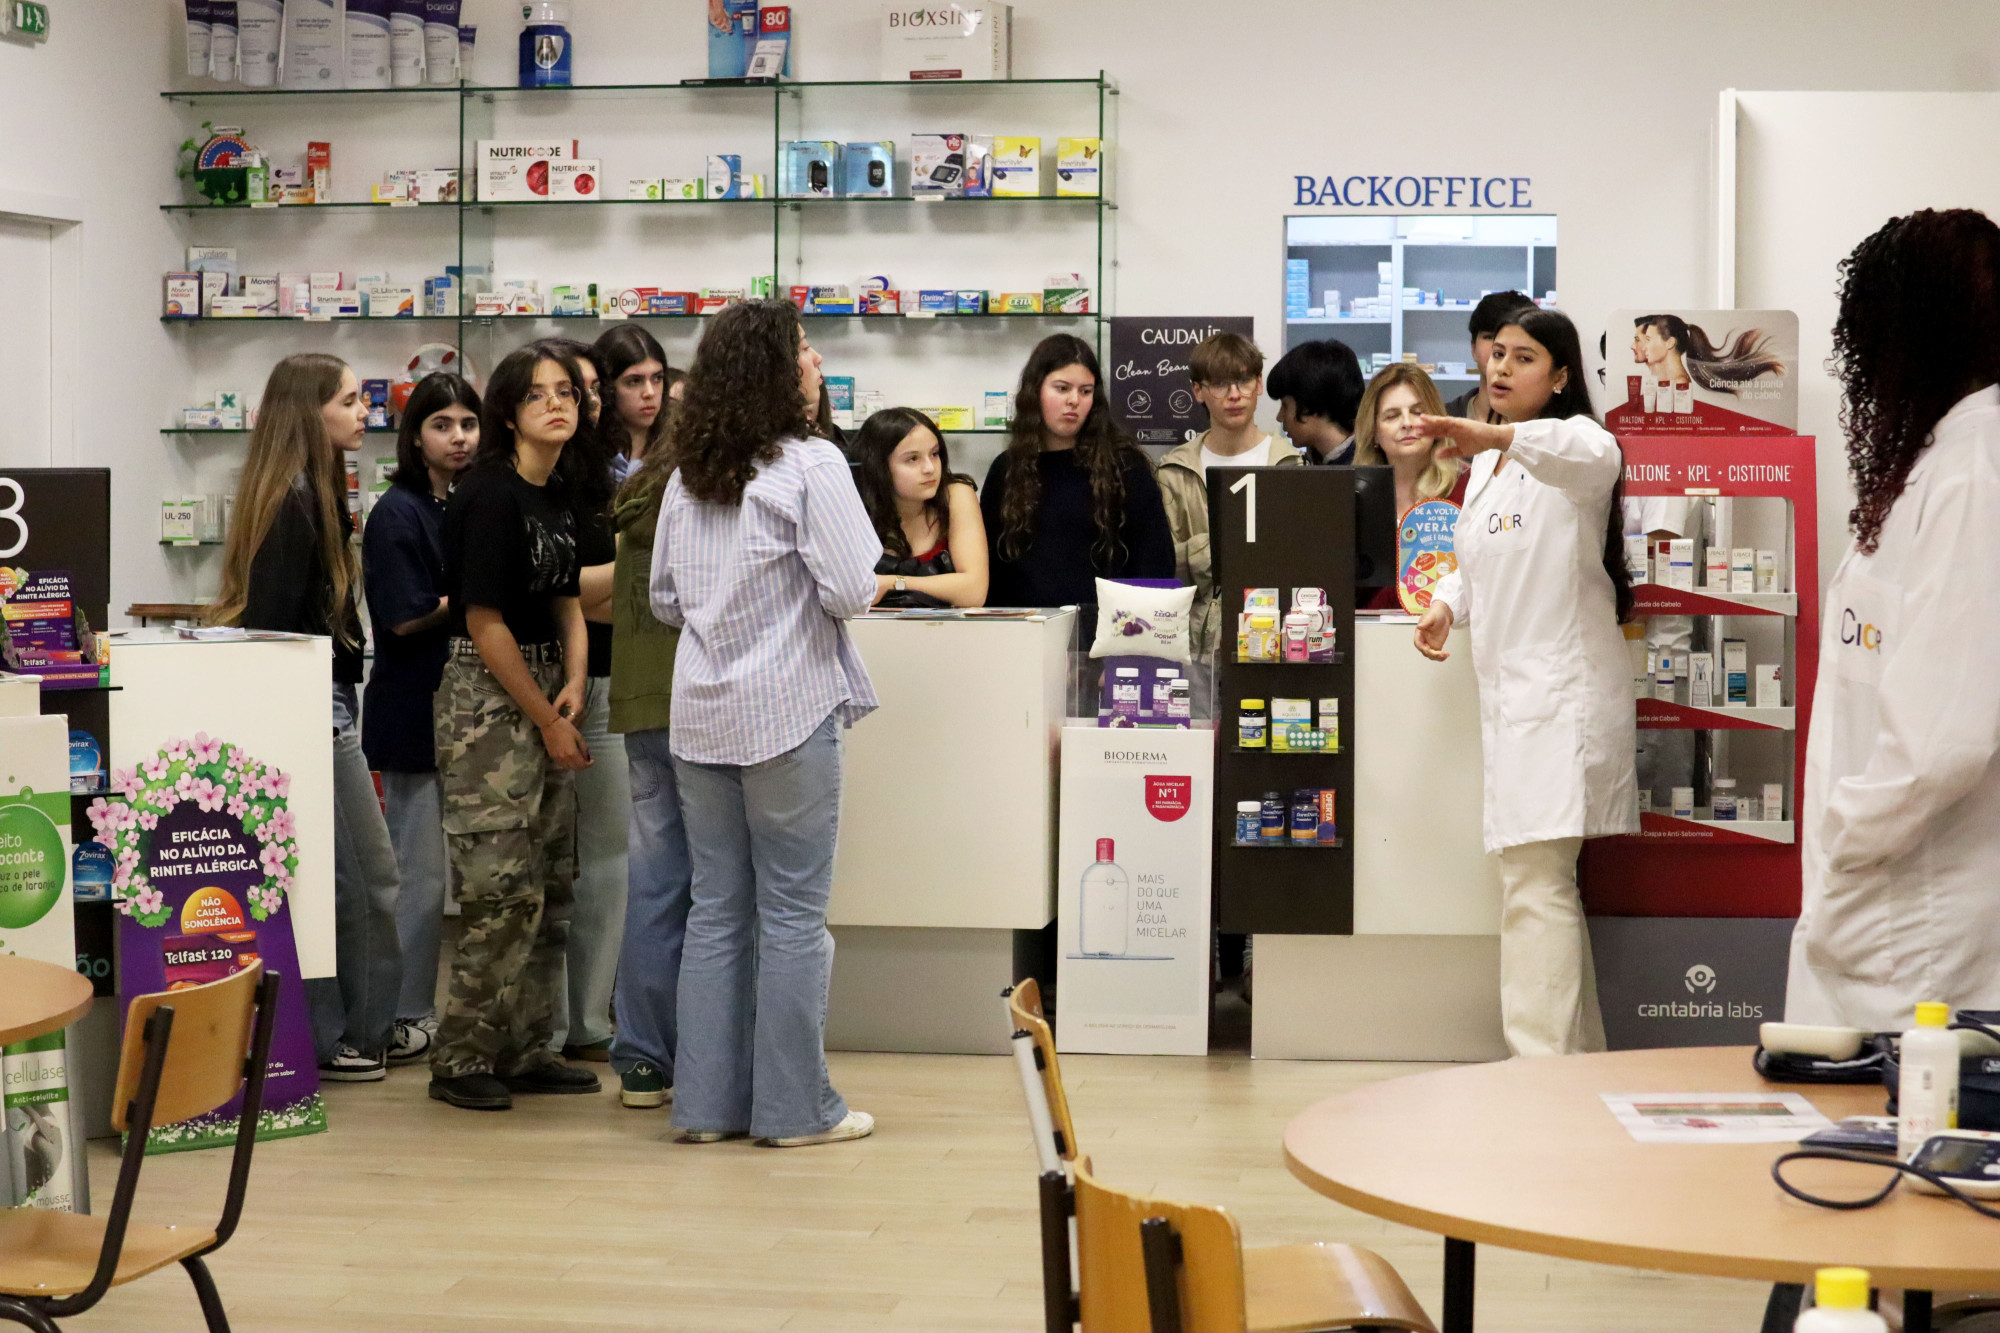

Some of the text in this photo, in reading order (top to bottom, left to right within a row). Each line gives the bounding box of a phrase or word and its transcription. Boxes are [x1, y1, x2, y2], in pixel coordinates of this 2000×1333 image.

[1294, 175, 1532, 208] BACKOFFICE
[622, 299, 638, 307] Drill
[651, 298, 677, 306] Maxilase
[1008, 298, 1032, 306] CETIX
[1115, 360, 1152, 380] Clean
[1156, 359, 1190, 377] Beau
[1624, 465, 1792, 482] ALTONE KPL CISTITONE
[1229, 473, 1256, 543] 1
[165, 512, 191, 520] UL-250
[1416, 521, 1457, 532] VERÃO
[1104, 751, 1168, 761] BIODERMA
[172, 827, 232, 843] EFICÁCIA
[79, 850, 106, 861] Zovirax
[160, 844, 246, 860] NO ALÍVIO DA
[150, 859, 258, 878] RINITE ALÉRGICA
[22, 869, 40, 880] pele
[1138, 874, 1164, 884] MAIS
[12, 883, 22, 892] de
[1138, 888, 1180, 898] DO QUE
[200, 897, 222, 907] NÃO
[1137, 900, 1162, 910] UMA
[196, 908, 227, 917] CAUSA
[1136, 912, 1168, 924] ÁGUA
[184, 917, 242, 929] SONOLÊNCIA
[1136, 928, 1187, 938] MICELAR
[165, 949, 232, 964] Telfast 120
[1638, 1001, 1763, 1018] cantabria labs
[5, 1058, 65, 1085] cellulase
